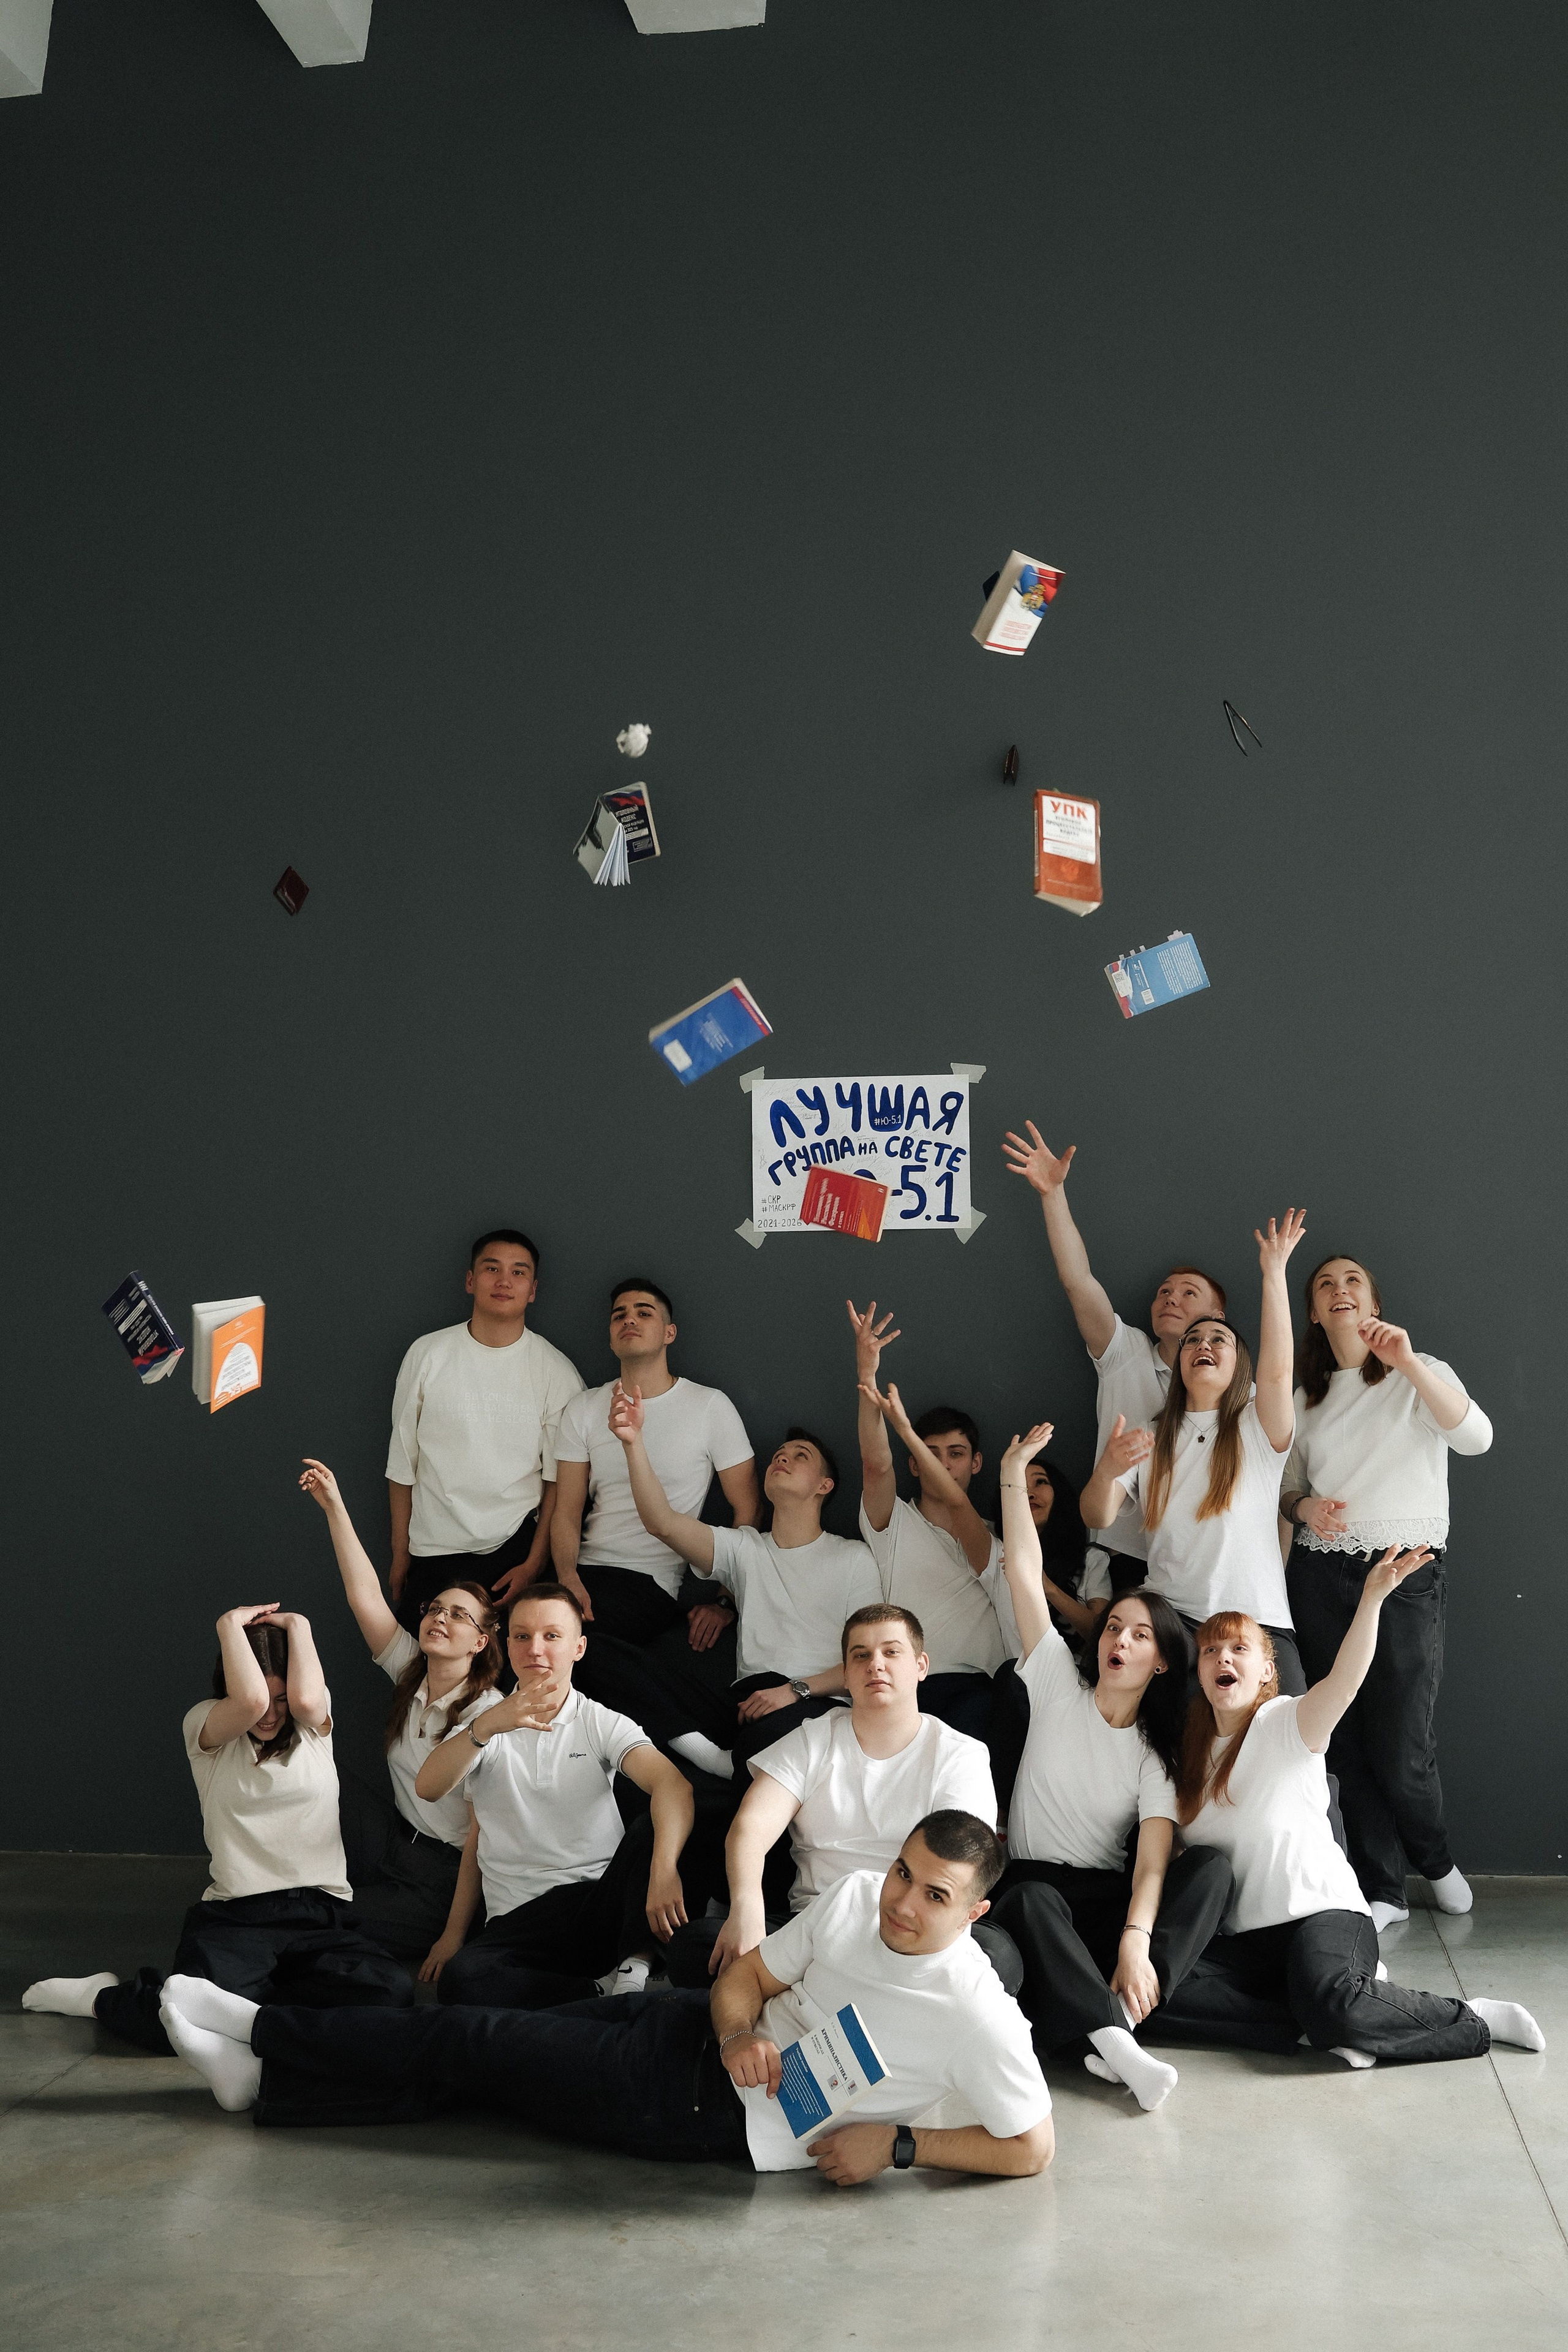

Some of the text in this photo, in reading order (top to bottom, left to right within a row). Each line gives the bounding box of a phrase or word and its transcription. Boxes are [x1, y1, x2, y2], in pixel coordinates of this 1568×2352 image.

[1050, 799, 1088, 821] УПК
[769, 1082, 964, 1147] ЛУЧШАЯ
[874, 1115, 902, 1126] #Ю-5.1
[768, 1136, 967, 1186] ГРУППА НА СВЕТЕ
[761, 1195, 781, 1204] #СКР
[761, 1204, 796, 1213] #МАСКРФ
[758, 1218, 802, 1228] 2021-2026
[464, 1392, 514, 1402] BULDING
[821, 2028, 848, 2081] КРИМИНАЛИСТИКА
